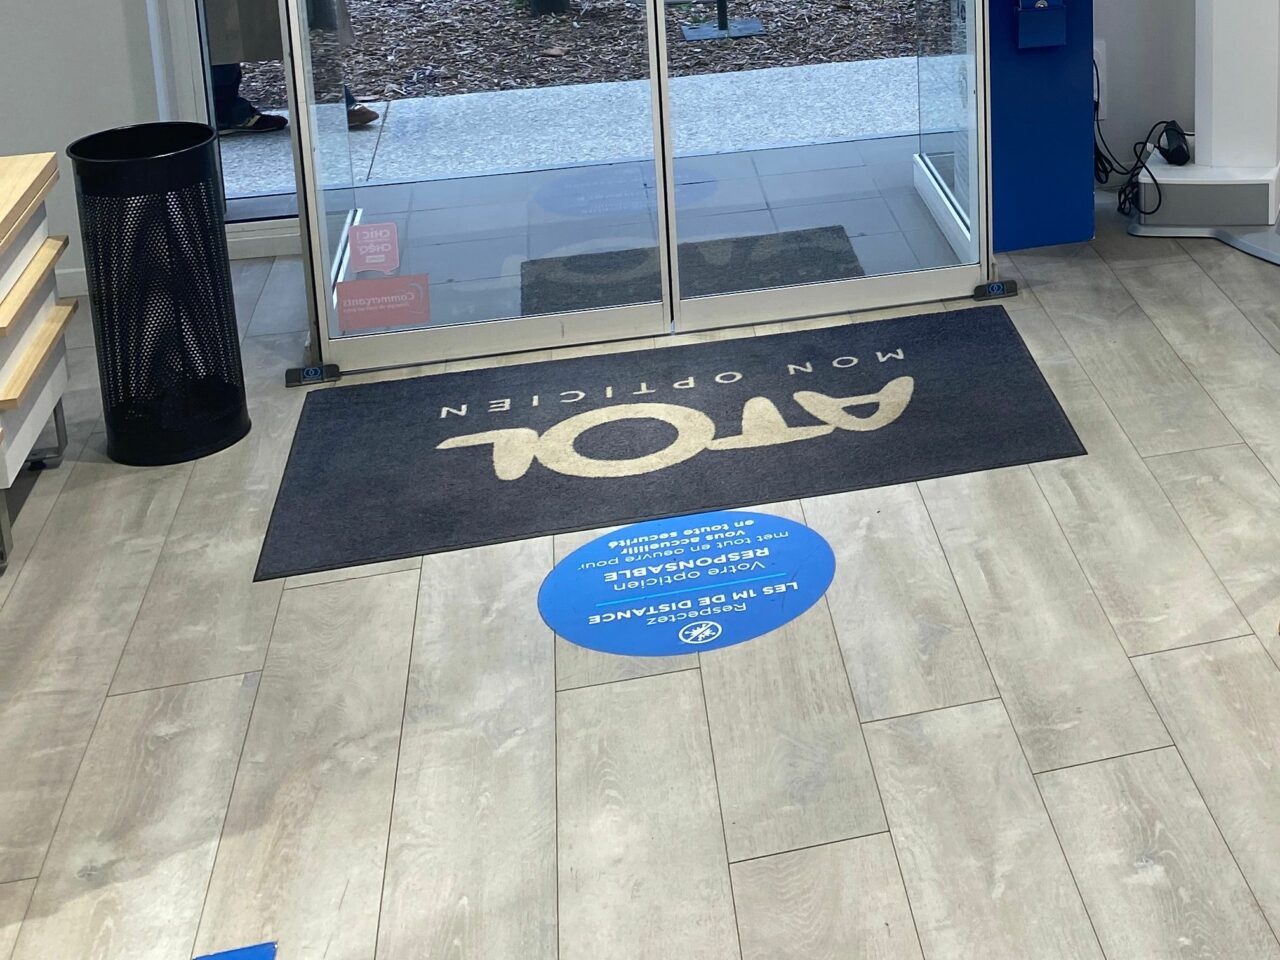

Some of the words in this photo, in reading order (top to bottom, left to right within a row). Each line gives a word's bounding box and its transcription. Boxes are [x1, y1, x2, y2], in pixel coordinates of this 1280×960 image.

[788, 348, 905, 375] MON
[440, 371, 743, 419] OPTICIEN
[435, 376, 914, 481] ATOL
[683, 522, 733, 537] toute
[734, 520, 755, 528] en
[705, 530, 745, 542] vous
[717, 535, 752, 548] tout
[756, 530, 789, 541] met
[620, 537, 700, 555] accueillir
[691, 544, 711, 552] en
[577, 557, 619, 571] pour
[604, 547, 770, 582] RESPONSABLE
[708, 560, 766, 577] Votre
[614, 569, 700, 592] opticien
[732, 588, 758, 601] 1M
[762, 581, 799, 596] LES
[700, 594, 726, 606] DE
[588, 599, 692, 625] DISTANCE
[647, 602, 747, 625] Respectez
